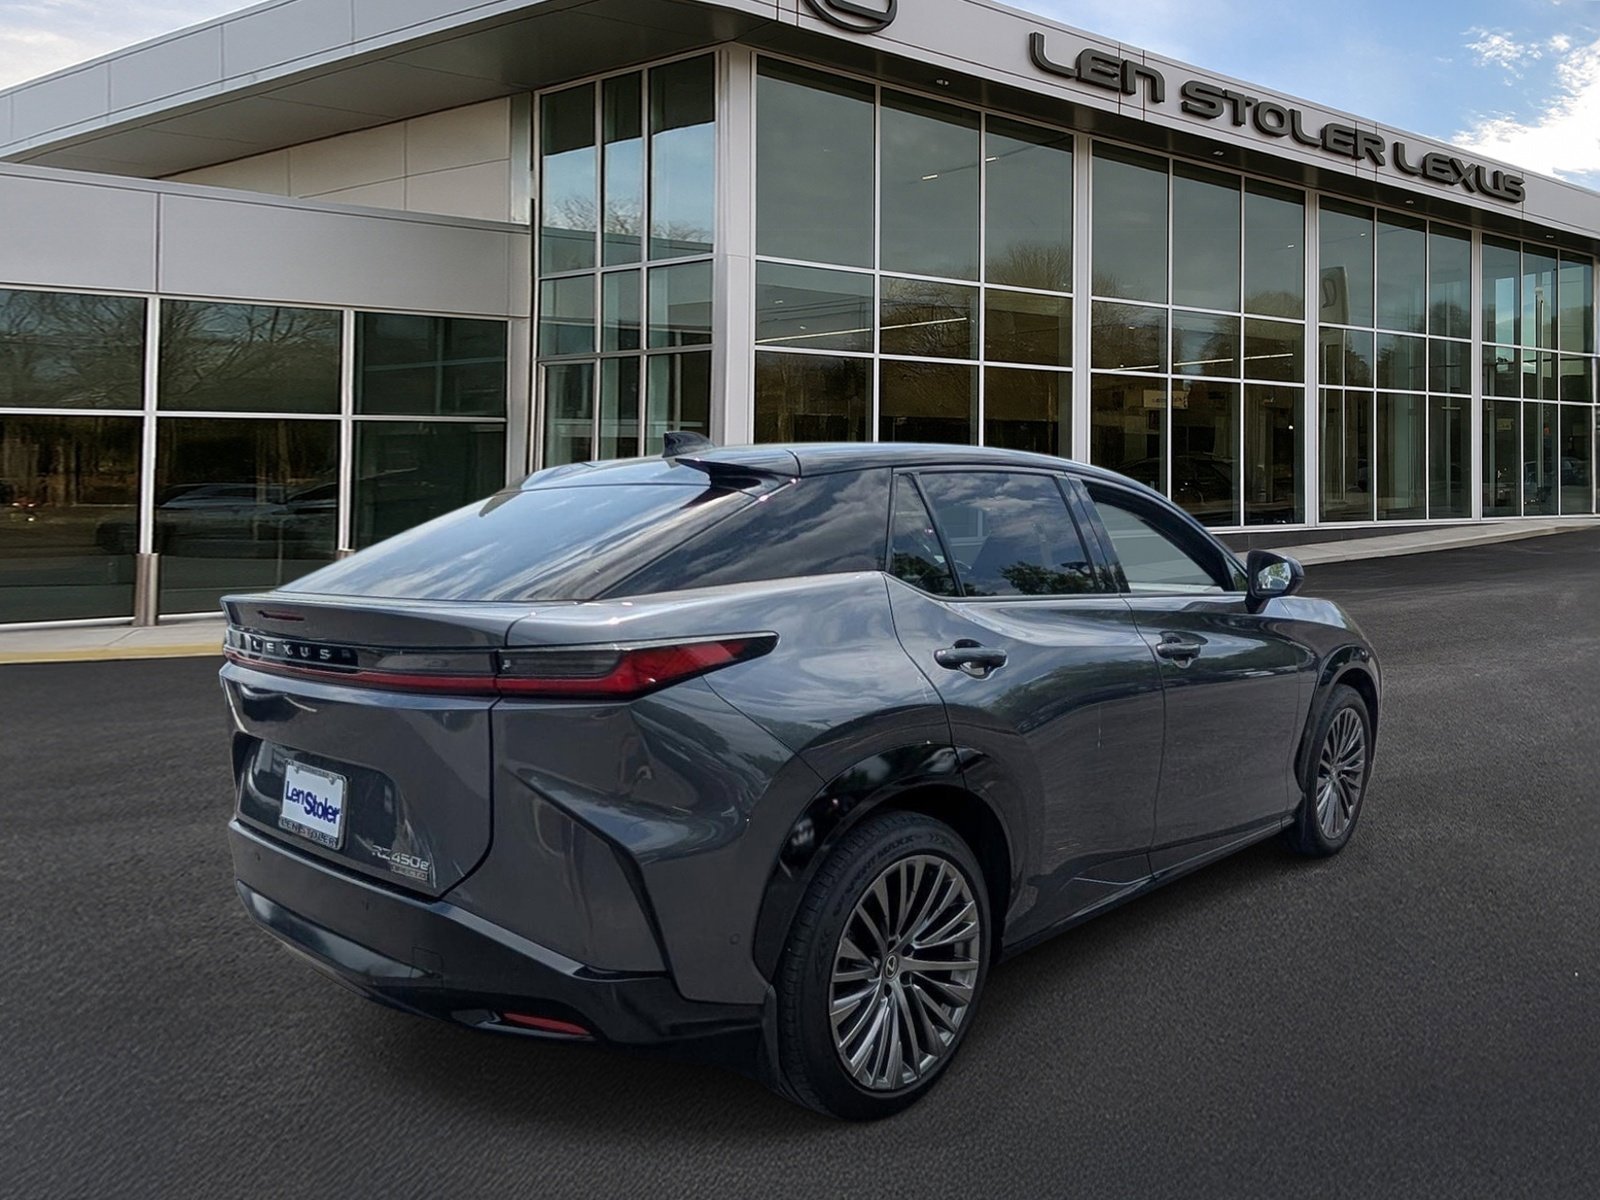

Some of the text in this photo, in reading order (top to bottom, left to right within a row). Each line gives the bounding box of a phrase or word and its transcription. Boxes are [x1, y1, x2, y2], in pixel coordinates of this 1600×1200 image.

[1029, 31, 1526, 204] LEN STOLER LEXUS
[252, 639, 332, 660] LEXUS
